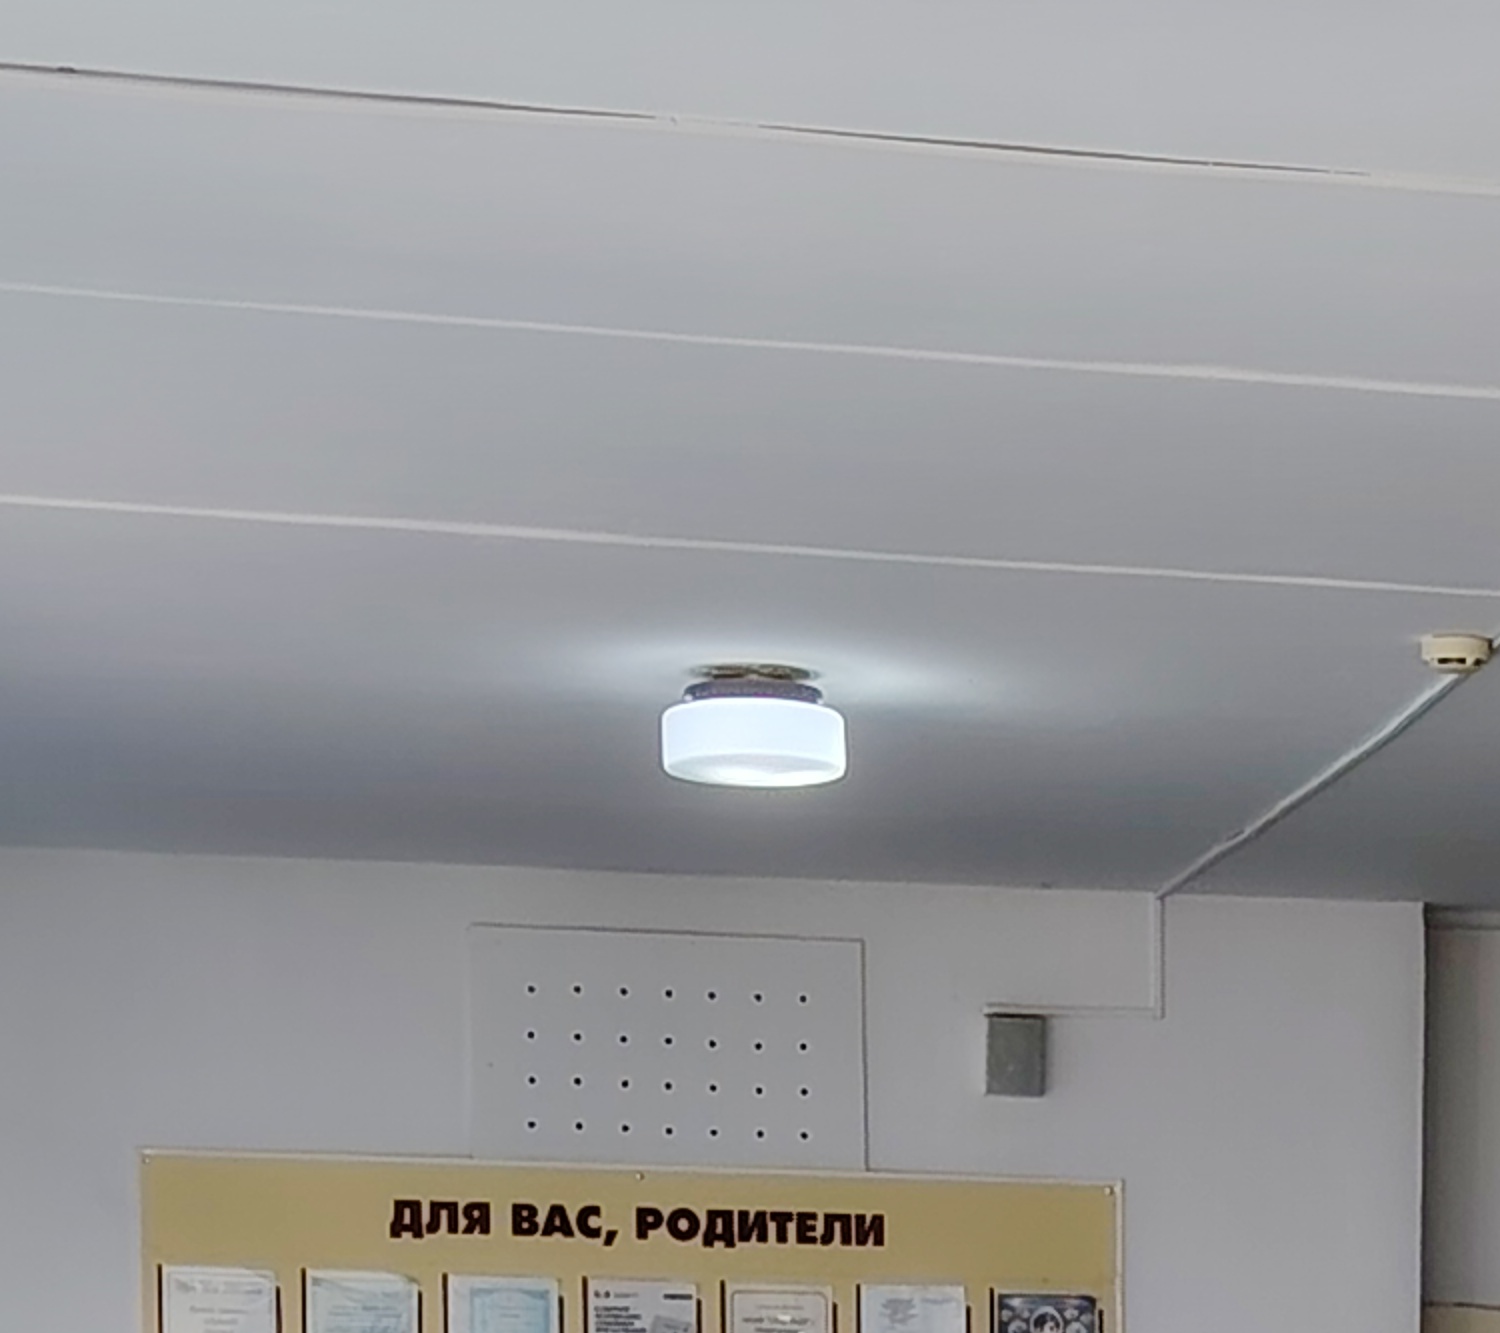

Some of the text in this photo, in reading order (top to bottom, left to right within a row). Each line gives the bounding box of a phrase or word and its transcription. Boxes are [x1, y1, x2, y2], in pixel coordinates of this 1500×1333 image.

[389, 1199, 886, 1248] ДЛЯ ВАС, РОДИТЕЛИ
